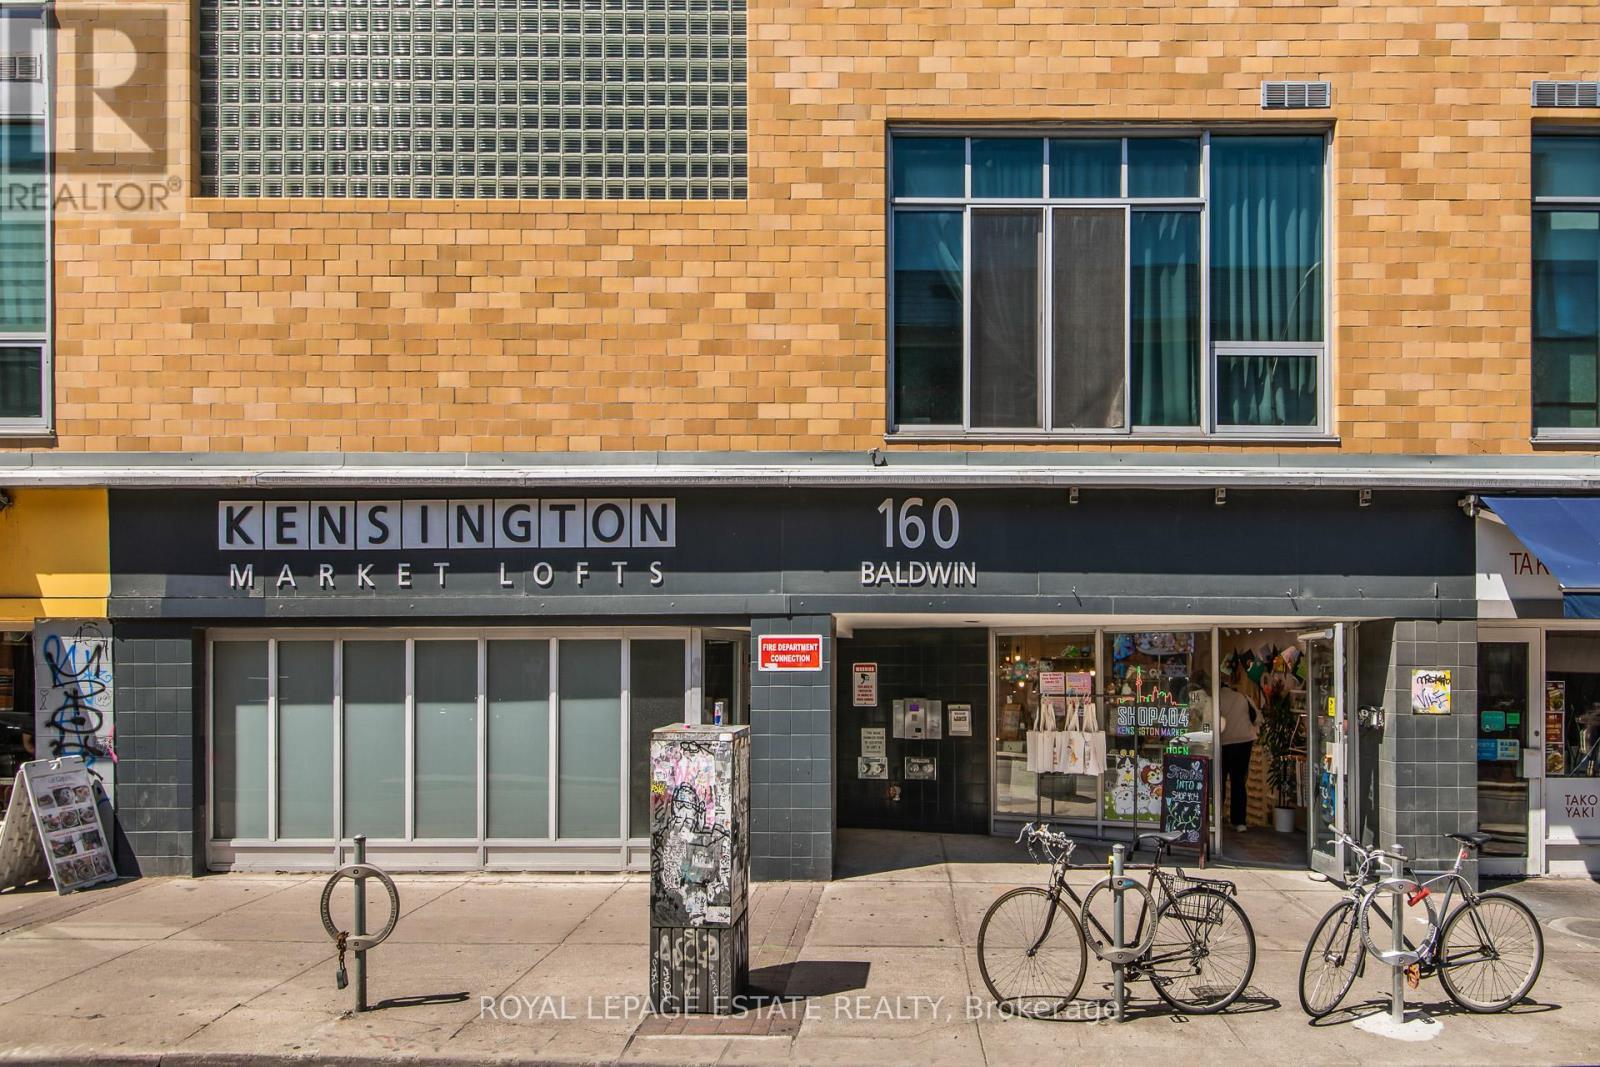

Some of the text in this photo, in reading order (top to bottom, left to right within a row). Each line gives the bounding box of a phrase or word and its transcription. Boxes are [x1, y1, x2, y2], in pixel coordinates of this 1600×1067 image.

[224, 502, 669, 545] KENSINGTON
[878, 497, 960, 549] 160
[229, 561, 664, 587] MARKET LOFTS
[861, 561, 977, 586] BALDWIN
[763, 643, 818, 651] FIRE DEPARTMENT
[770, 654, 811, 662] CONNECTION
[1117, 726, 1159, 736] KENSGTON
[1564, 794, 1598, 806] TAKO
[1565, 806, 1595, 818] YAKI
